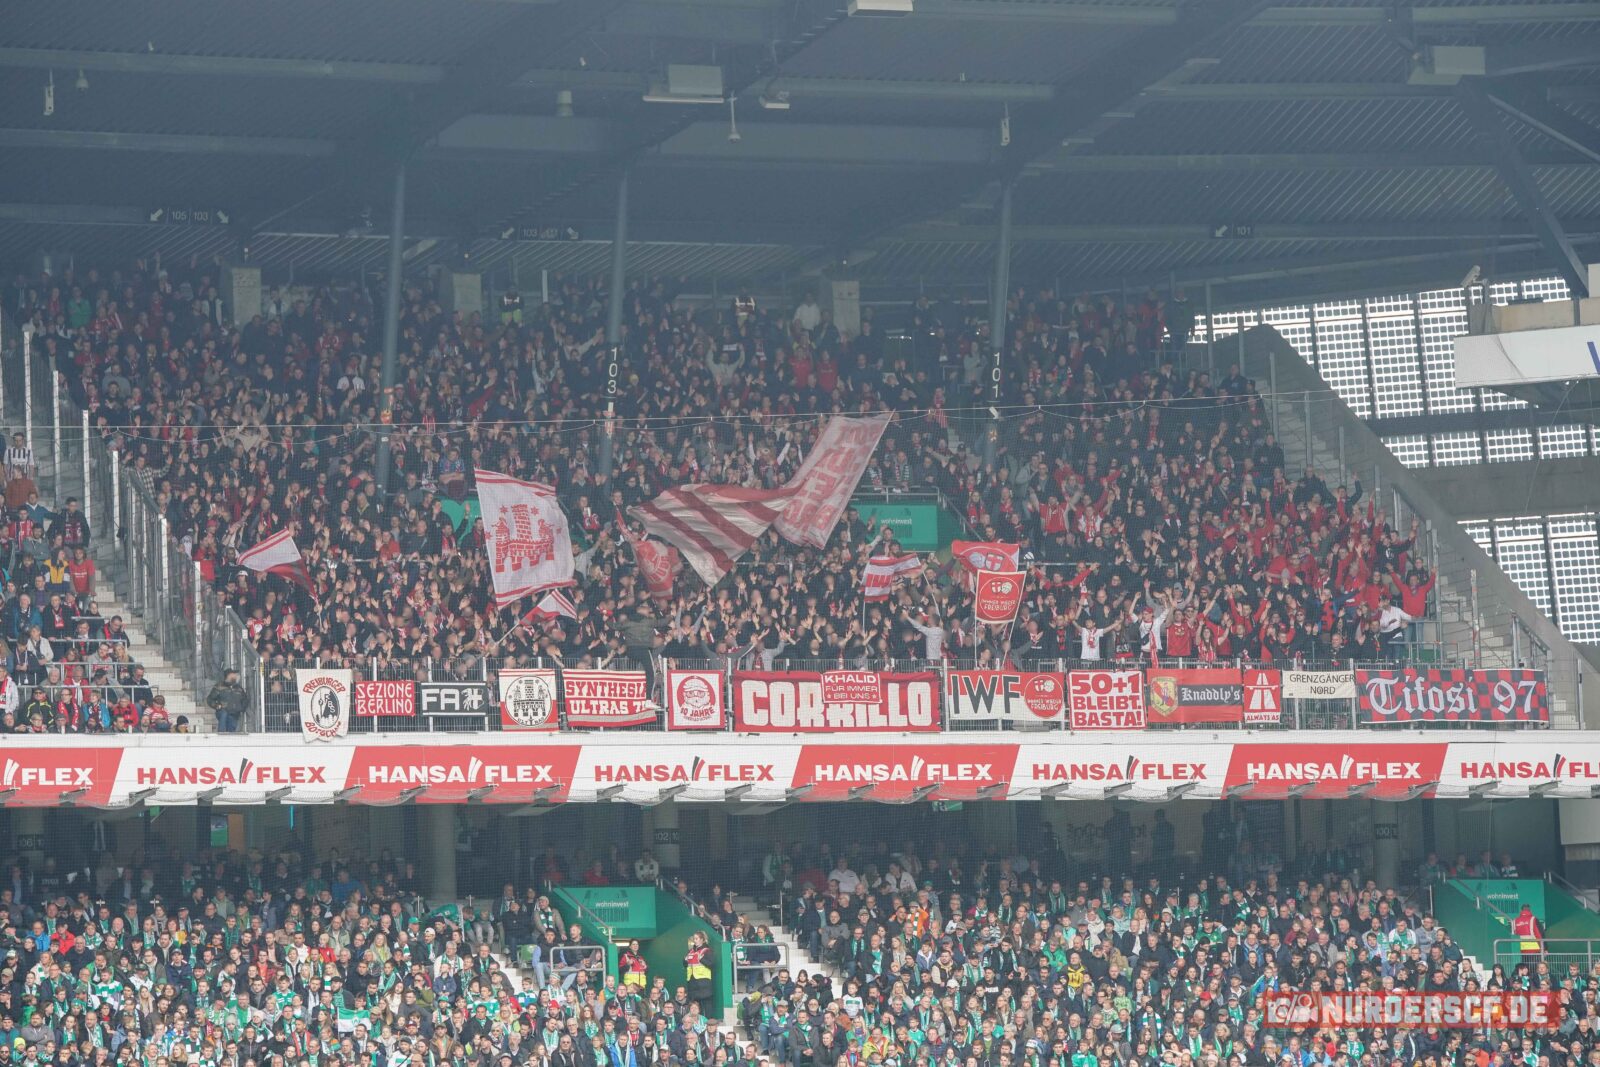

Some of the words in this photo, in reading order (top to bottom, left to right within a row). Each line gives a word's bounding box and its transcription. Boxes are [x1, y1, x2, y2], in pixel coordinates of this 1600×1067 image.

[608, 347, 617, 394] 103
[992, 352, 1000, 398] 101
[303, 677, 346, 694] FREIBURGER
[825, 674, 877, 683] KHALID
[1071, 673, 1141, 695] 50+1
[1289, 673, 1355, 684] GRENZGÄNGER
[356, 682, 412, 698] SEZIONE
[825, 684, 845, 692] FÜR
[951, 675, 1020, 715] IWF
[1181, 687, 1240, 703] Knaddly's
[1366, 676, 1477, 715] Tifosi
[1493, 680, 1537, 714] 97
[357, 699, 413, 714] BERLINO
[569, 699, 629, 715] ULTRAS
[1073, 695, 1141, 710] BLEIBT.
[690, 706, 715, 717] JAHRE
[1074, 711, 1142, 726] BASTA!
[22, 768, 93, 785] FLEX
[137, 767, 240, 784] HANSA
[257, 767, 326, 784] FLEX
[368, 766, 469, 783] HANSA
[485, 766, 553, 783] FLEX
[595, 765, 687, 782] HANSA
[709, 765, 774, 782] FLEX
[814, 764, 913, 781] HANSA
[928, 764, 993, 781] FLEX
[1032, 763, 1127, 780] HANSA
[1142, 763, 1207, 780] FLEX
[1247, 763, 1341, 780] HANSA
[1356, 762, 1422, 779] FLEX
[1461, 762, 1553, 778] HANSA
